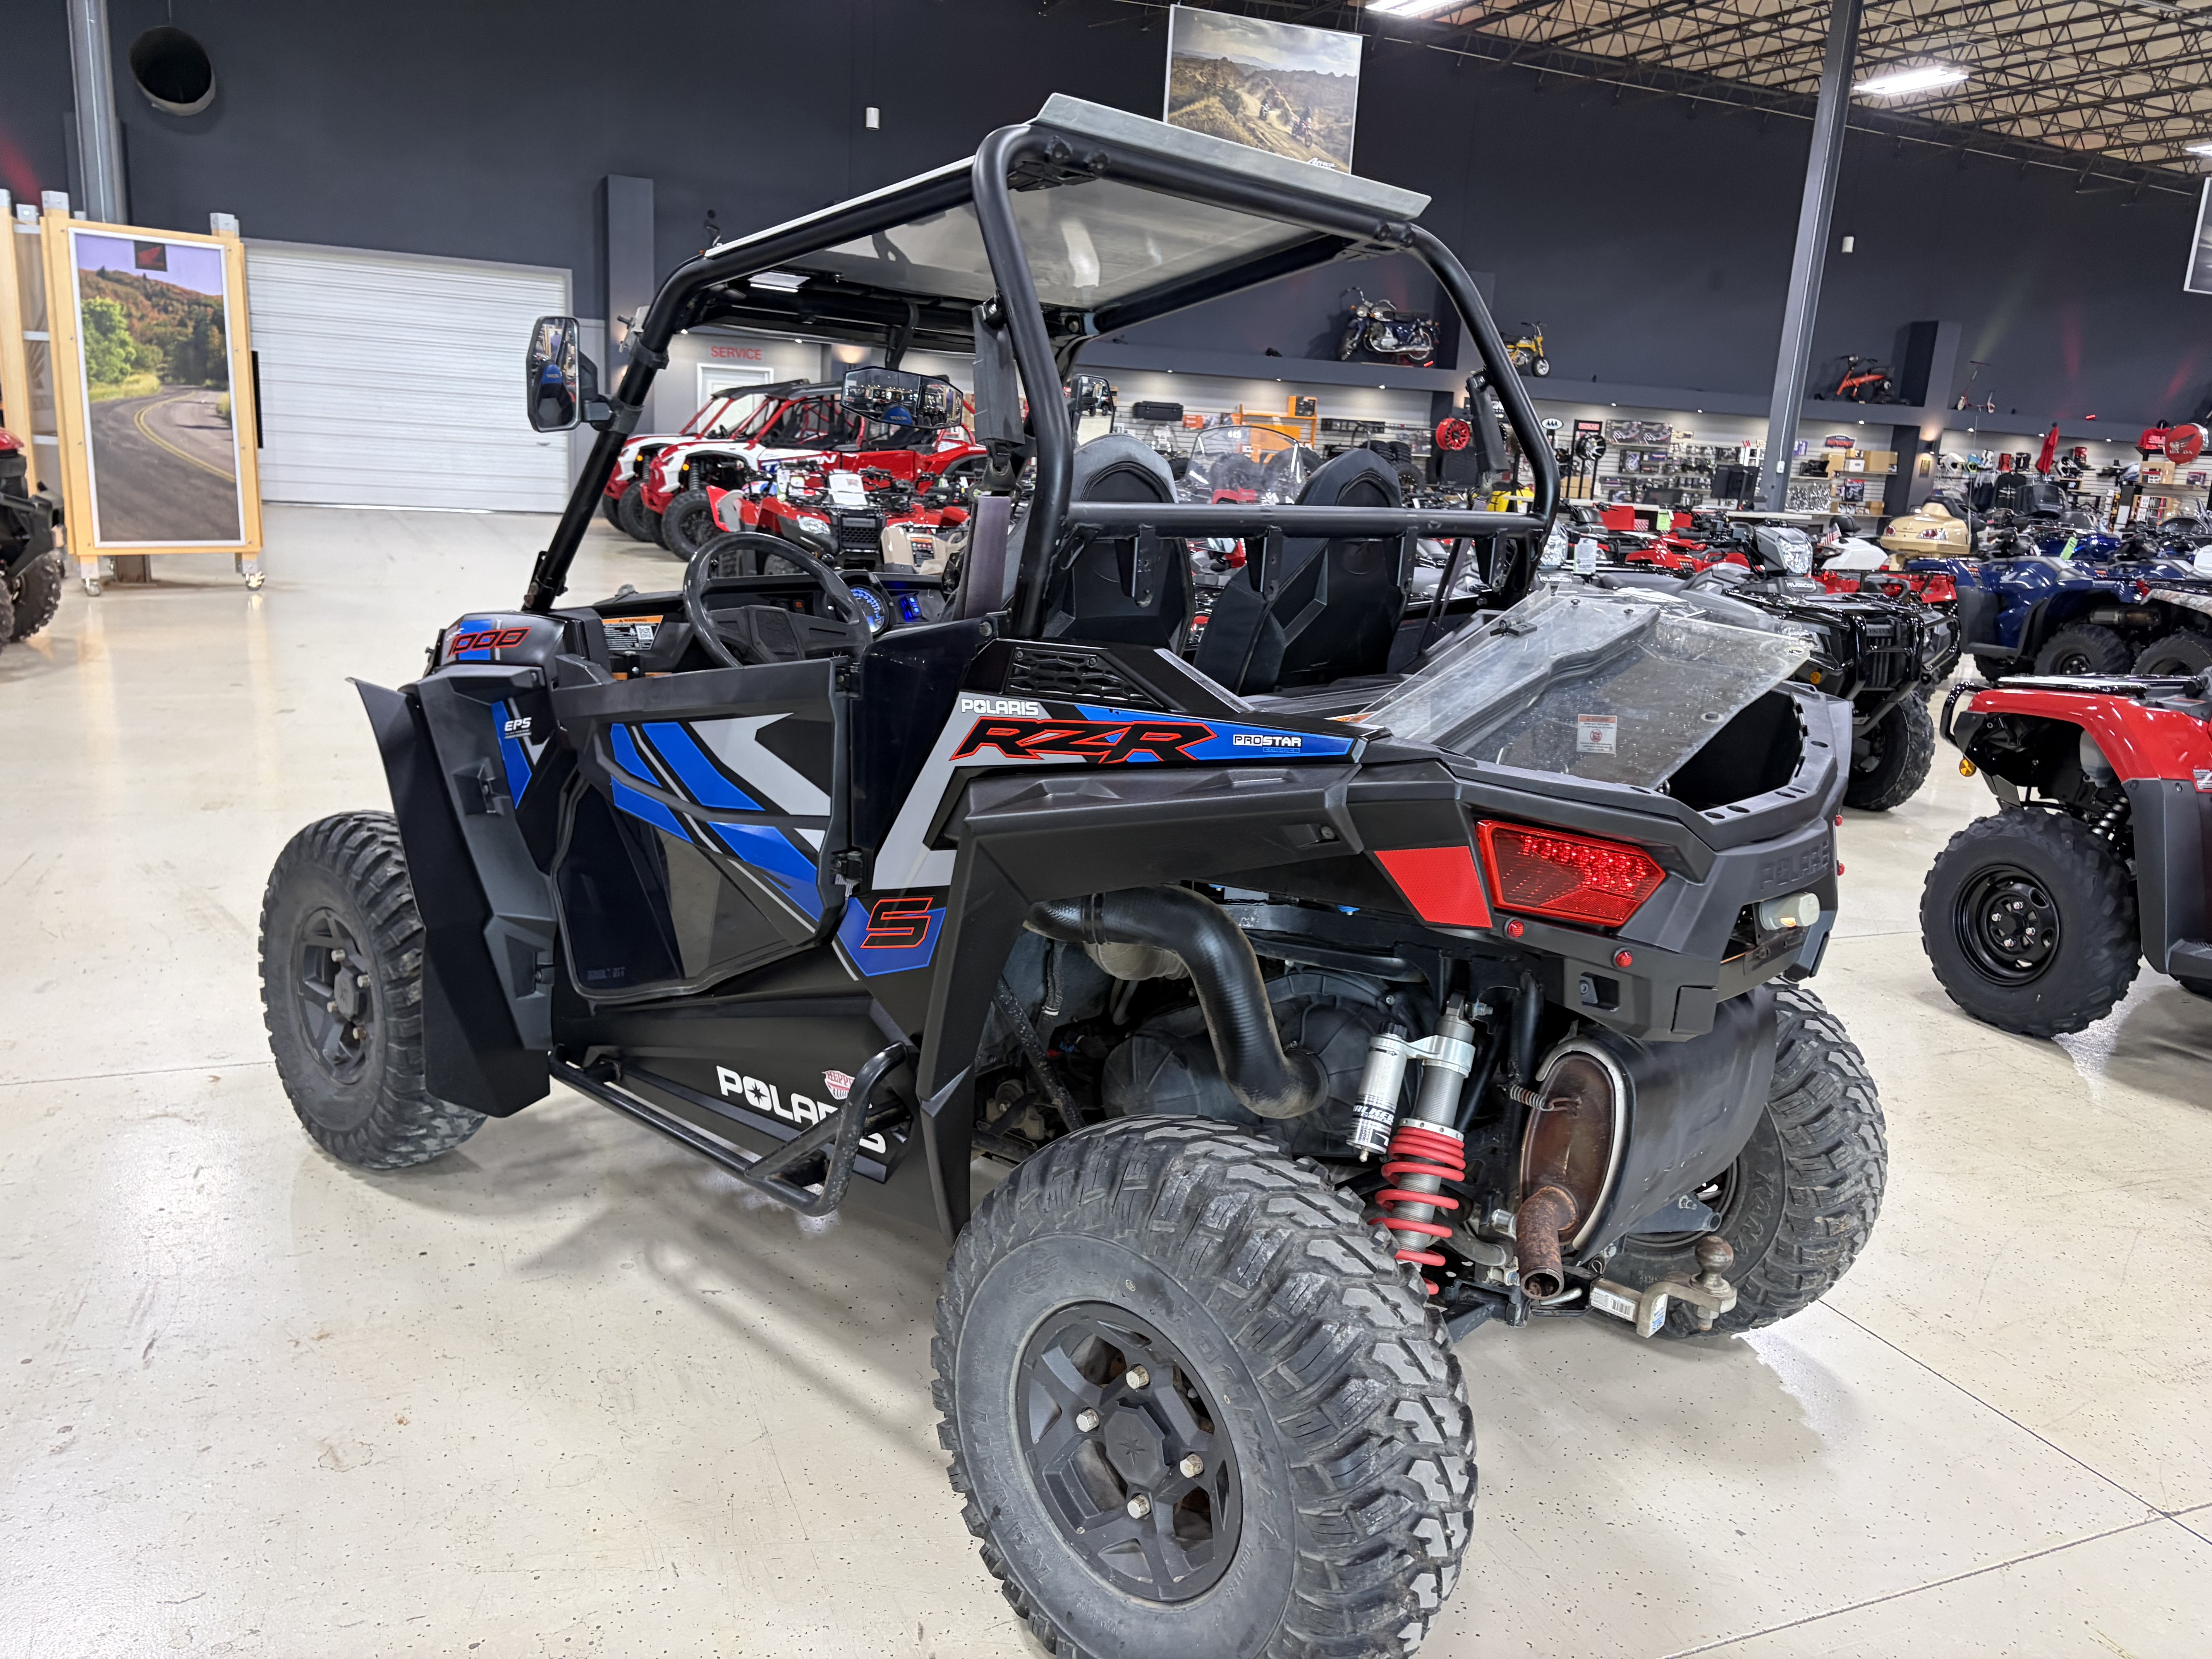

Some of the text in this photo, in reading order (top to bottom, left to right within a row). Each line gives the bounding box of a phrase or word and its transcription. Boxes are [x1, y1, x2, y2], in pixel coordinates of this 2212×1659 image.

[711, 346, 763, 360] SERVICE
[961, 698, 1039, 716] POLARIS
[504, 717, 532, 732] EPS
[948, 716, 1217, 764] RZR
[1233, 734, 1301, 747] PROSTAR
[860, 897, 933, 948] S
